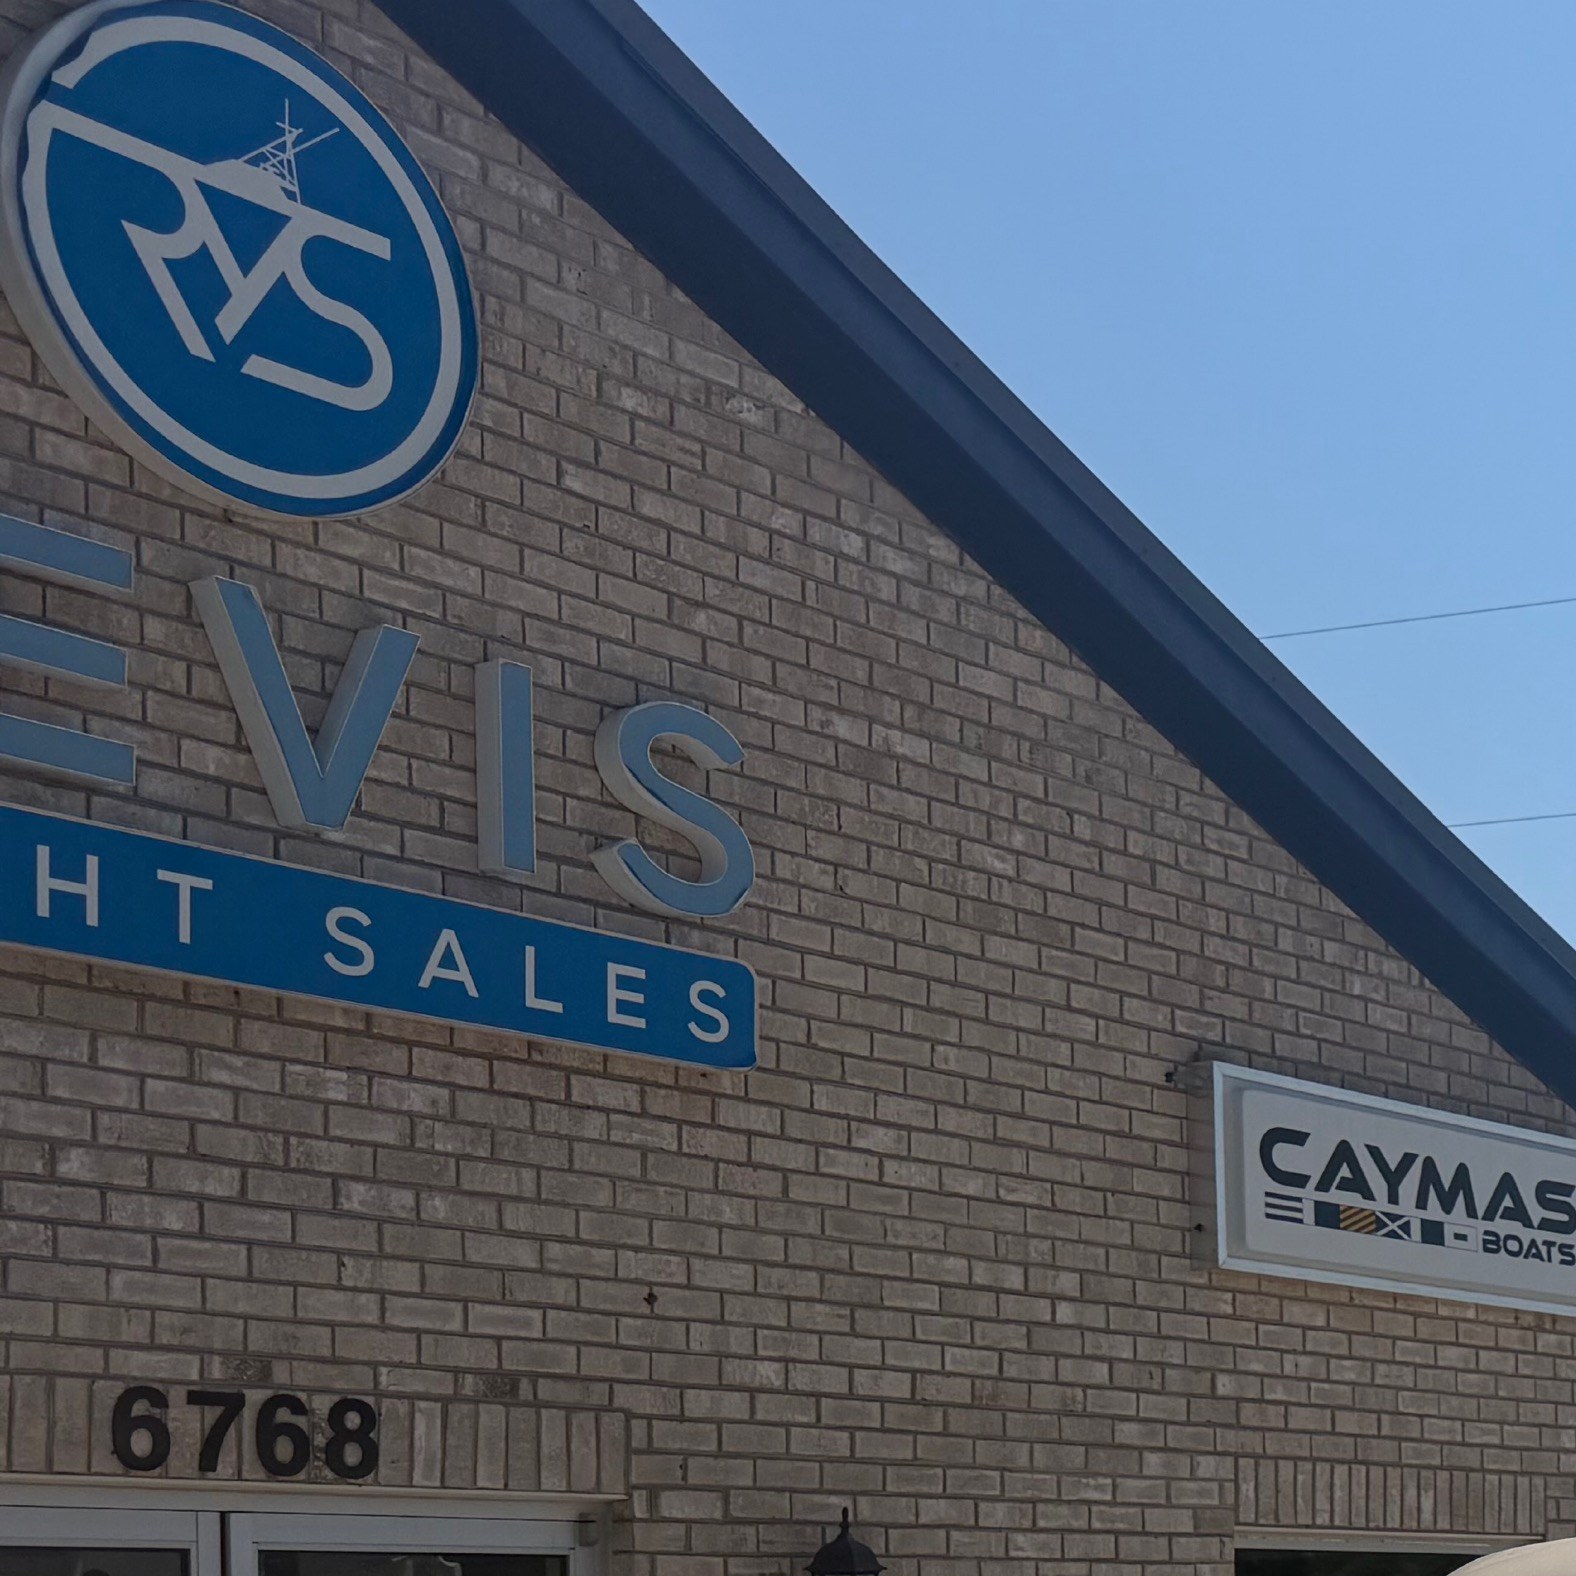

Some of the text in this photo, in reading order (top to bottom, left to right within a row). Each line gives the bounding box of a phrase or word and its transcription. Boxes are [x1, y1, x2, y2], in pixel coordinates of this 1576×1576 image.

[322, 905, 732, 1044] SALES
[1482, 1230, 1576, 1266] BOATS
[110, 1384, 380, 1480] 6768
